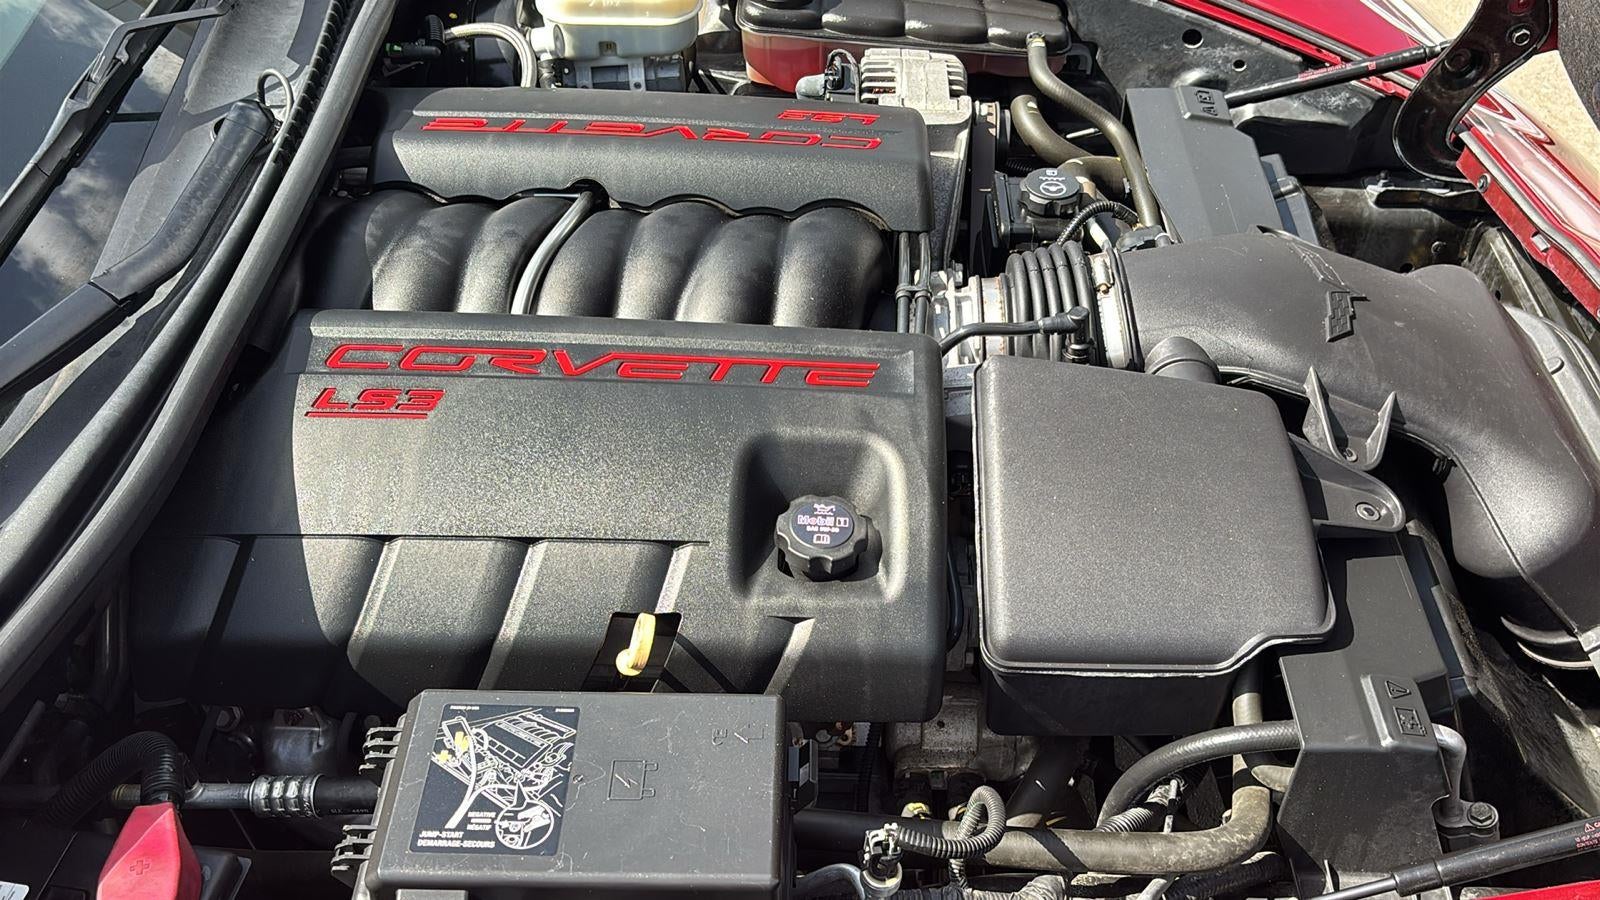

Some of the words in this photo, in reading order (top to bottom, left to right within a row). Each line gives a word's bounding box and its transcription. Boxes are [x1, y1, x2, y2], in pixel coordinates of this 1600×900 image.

[777, 109, 879, 125] LS3
[421, 118, 882, 149] CORVETTE
[325, 344, 881, 387] CORVETTE
[312, 387, 446, 410] LS3
[797, 515, 834, 526] Mobil
[419, 830, 464, 838] JUMP-START
